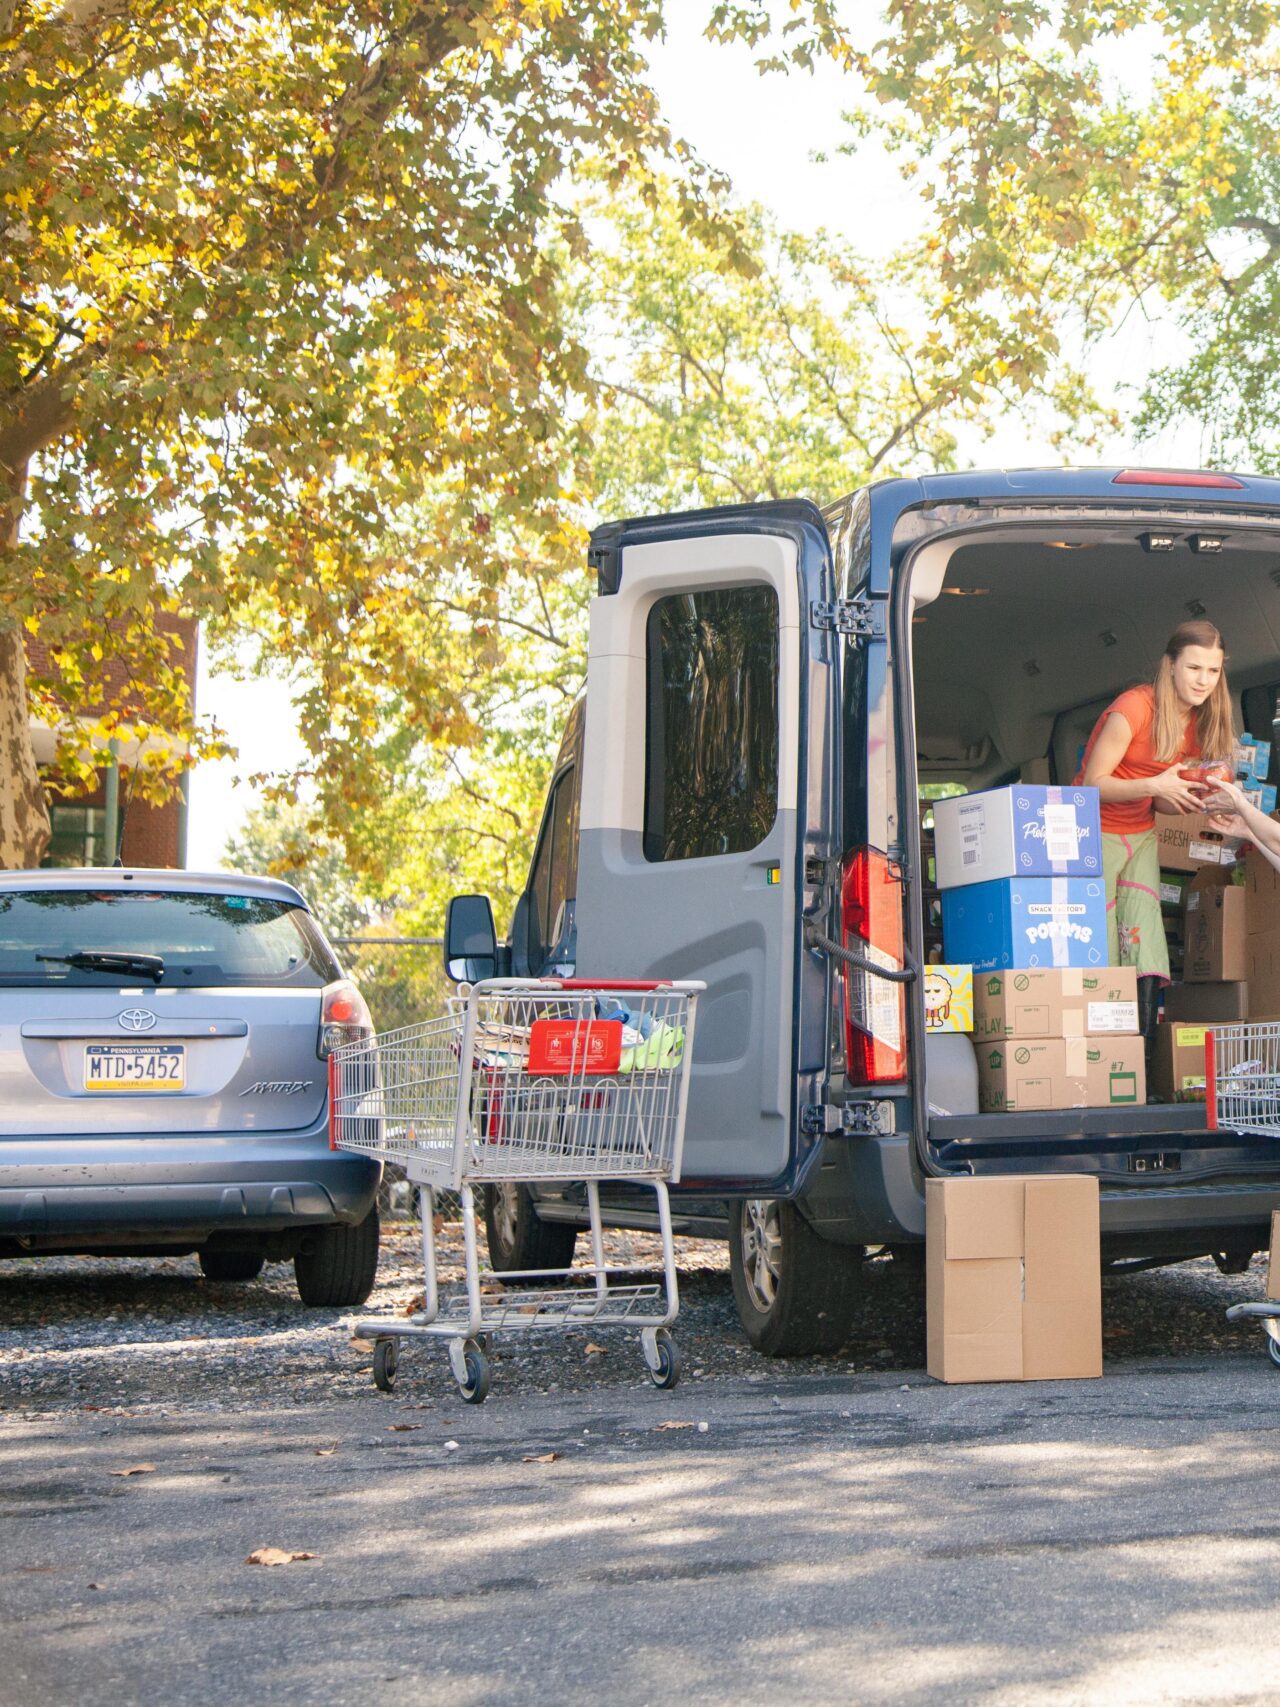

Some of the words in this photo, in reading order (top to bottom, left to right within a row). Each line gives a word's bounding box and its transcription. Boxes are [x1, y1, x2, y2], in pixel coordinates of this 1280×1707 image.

[1163, 828, 1190, 848] FRESH
[988, 982, 1000, 993] UP
[1108, 990, 1121, 1000] #7
[991, 1056, 1000, 1065] UP
[1111, 1061, 1124, 1071] #7
[238, 1081, 313, 1097] MATRIX
